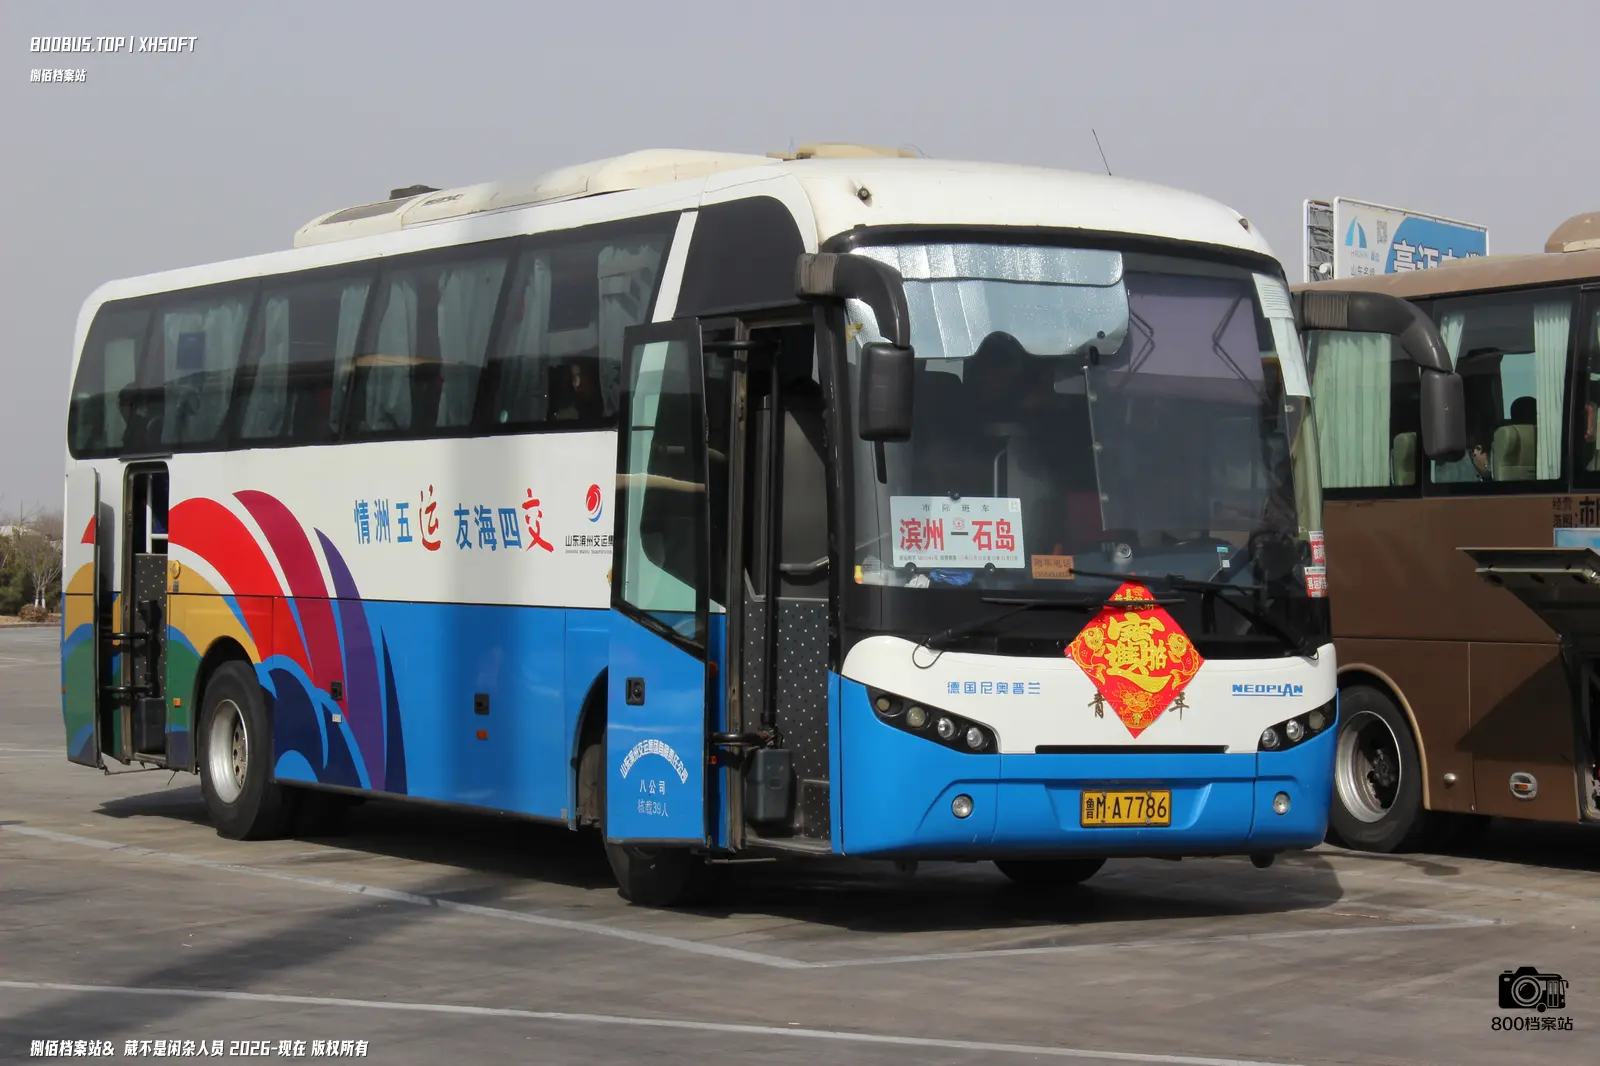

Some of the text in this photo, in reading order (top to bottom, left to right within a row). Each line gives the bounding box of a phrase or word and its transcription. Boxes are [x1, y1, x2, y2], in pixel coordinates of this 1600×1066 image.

[947, 681, 1040, 695] 德国尼奥普兰
[1232, 683, 1303, 697] NEOPLAN
